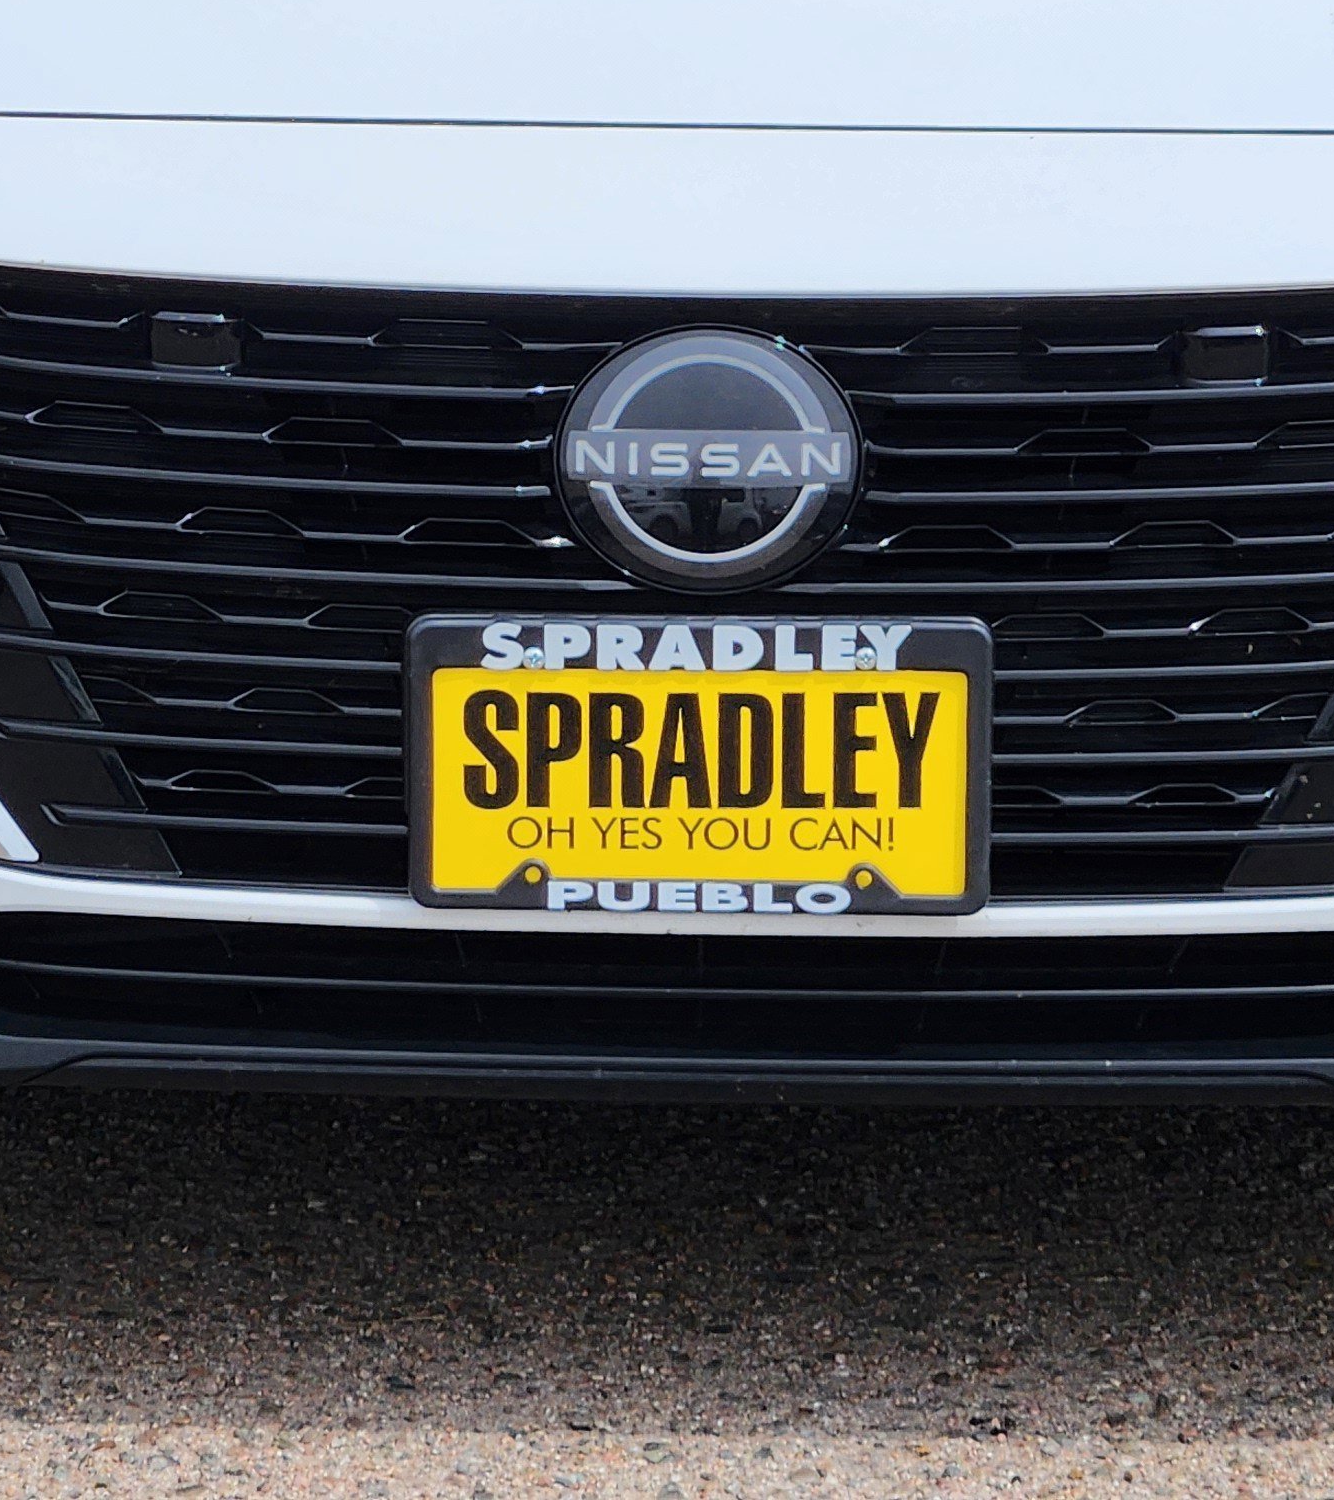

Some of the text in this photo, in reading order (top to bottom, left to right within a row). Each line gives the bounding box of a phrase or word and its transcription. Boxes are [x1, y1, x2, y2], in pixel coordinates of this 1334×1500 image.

[574, 440, 842, 479] NISSAN
[481, 623, 912, 671] SPRADLEY
[462, 689, 941, 809] SPRADLEY
[507, 817, 894, 852] OH YES YOU CAN!
[547, 881, 852, 914] PUEBLO
